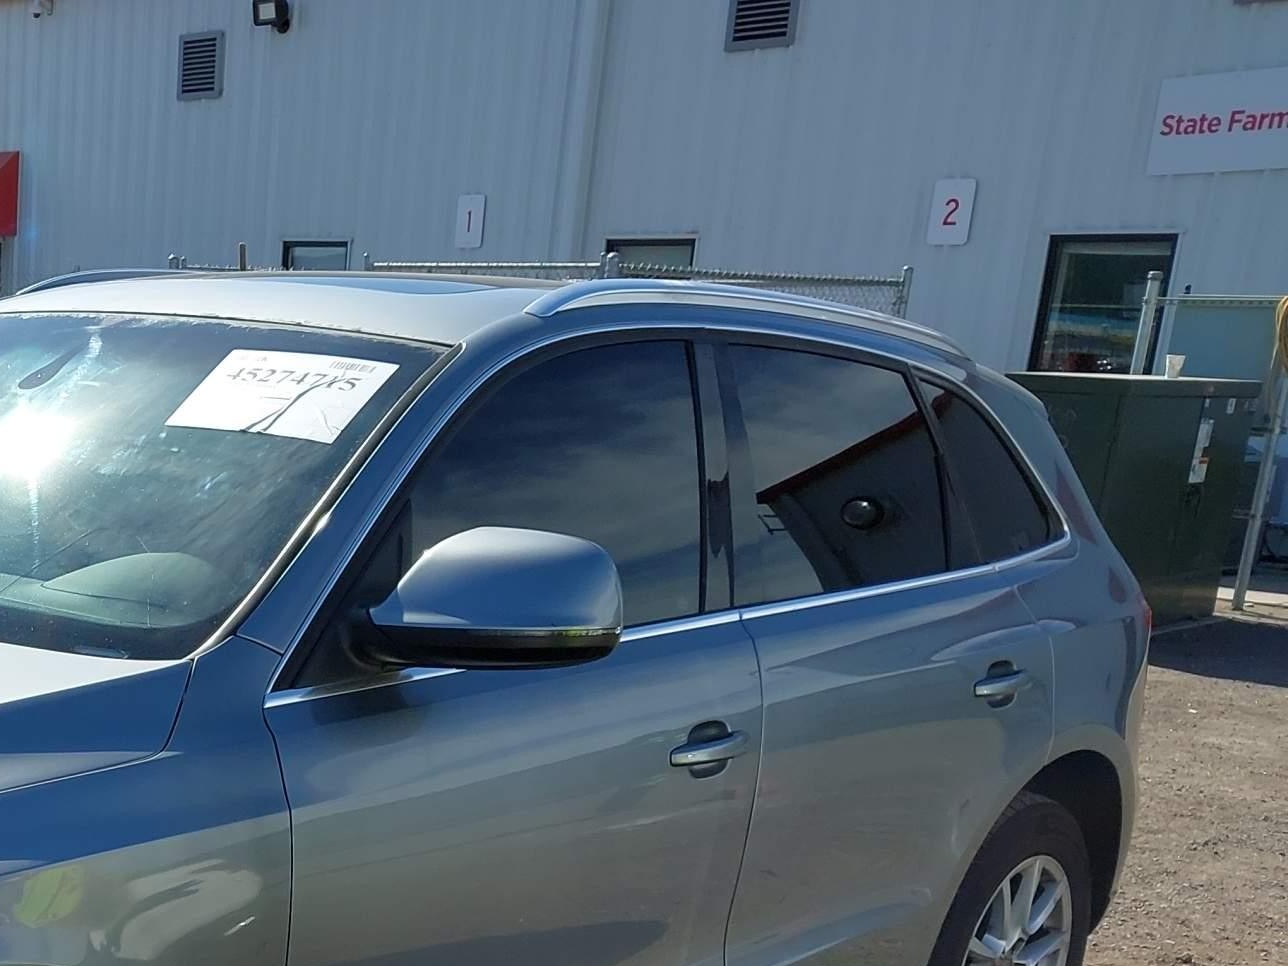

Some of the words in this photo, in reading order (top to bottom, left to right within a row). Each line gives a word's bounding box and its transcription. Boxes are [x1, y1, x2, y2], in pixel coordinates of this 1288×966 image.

[1160, 113, 1221, 136] State
[1227, 110, 1288, 132] Farm
[466, 210, 474, 233] 1
[941, 198, 961, 226] 2
